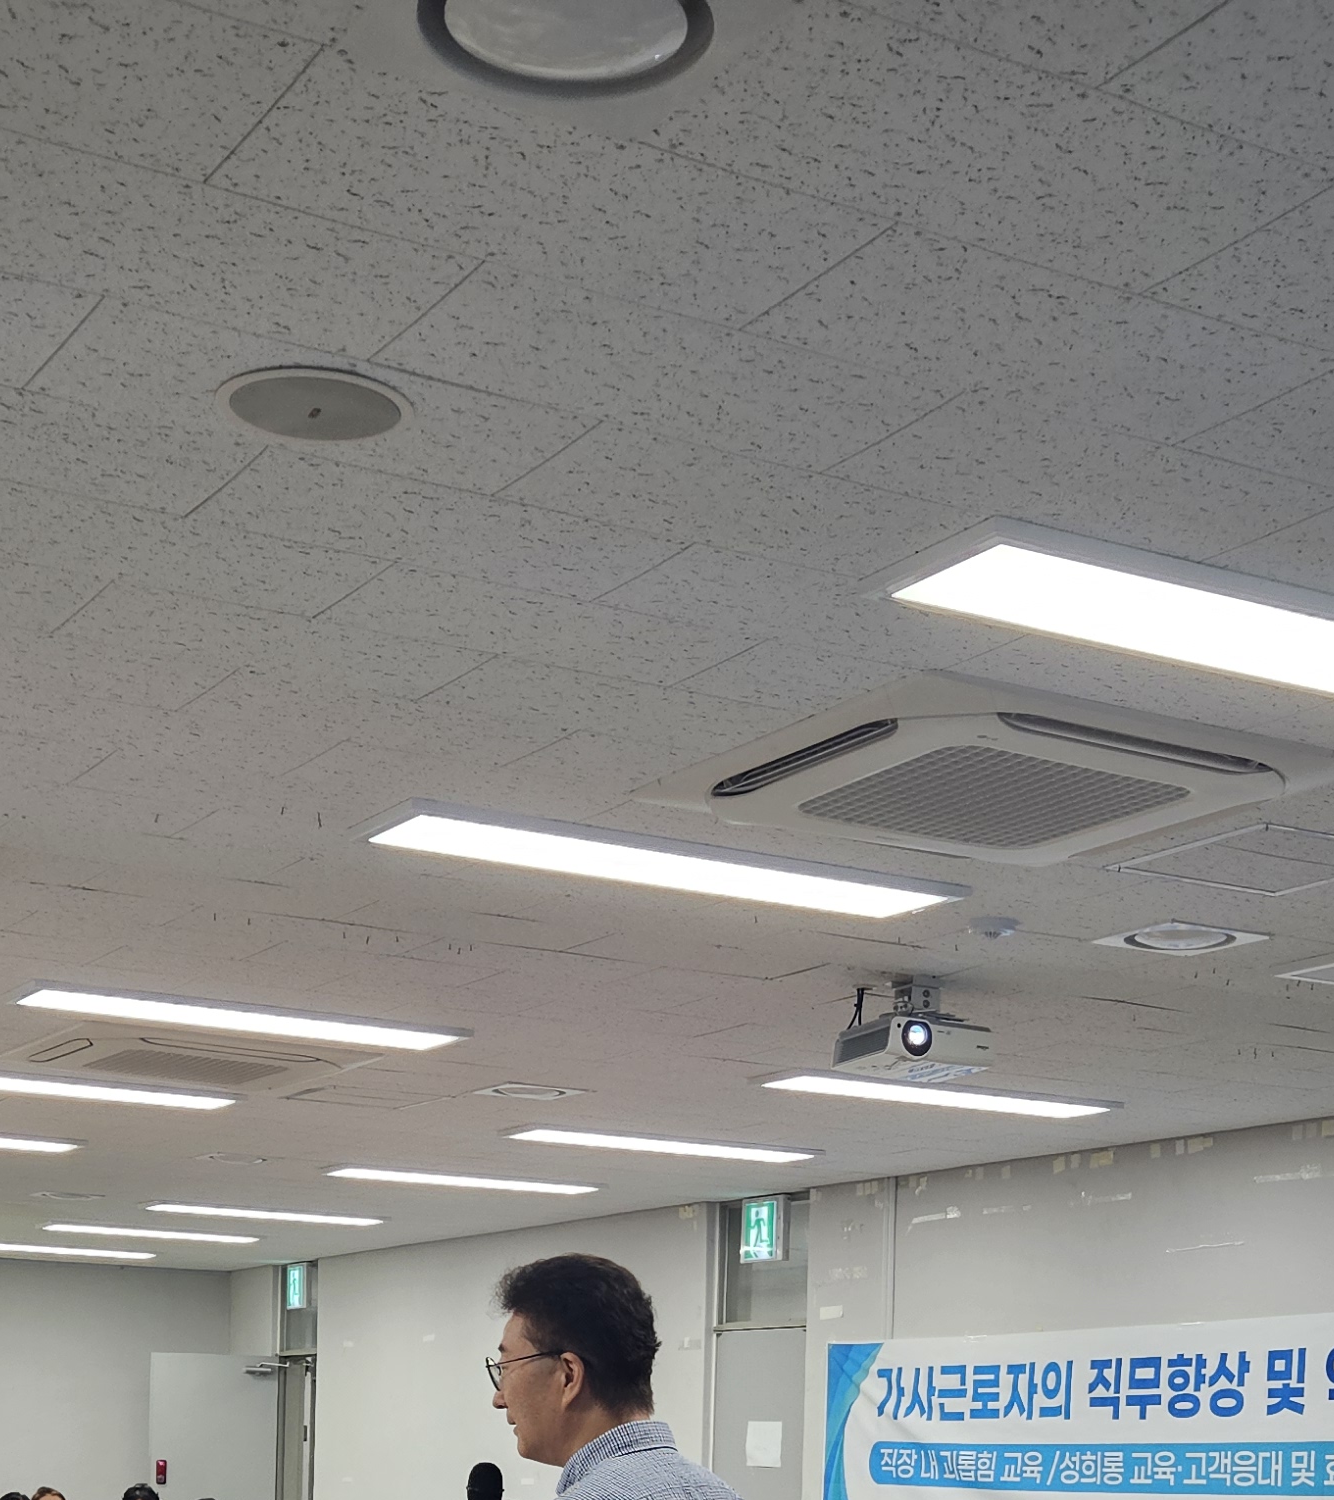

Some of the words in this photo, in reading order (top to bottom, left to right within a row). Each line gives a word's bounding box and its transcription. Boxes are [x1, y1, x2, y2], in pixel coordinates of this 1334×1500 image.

[875, 1360, 1074, 1422] 가사근로자의
[1087, 1350, 1251, 1421] 직무향상
[1266, 1346, 1307, 1416] 및
[879, 1448, 918, 1479] 직장
[920, 1449, 939, 1481] 내
[939, 1450, 996, 1483] 괴롭힘
[1000, 1451, 1044, 1484] 교육
[1291, 1449, 1316, 1488] 및
